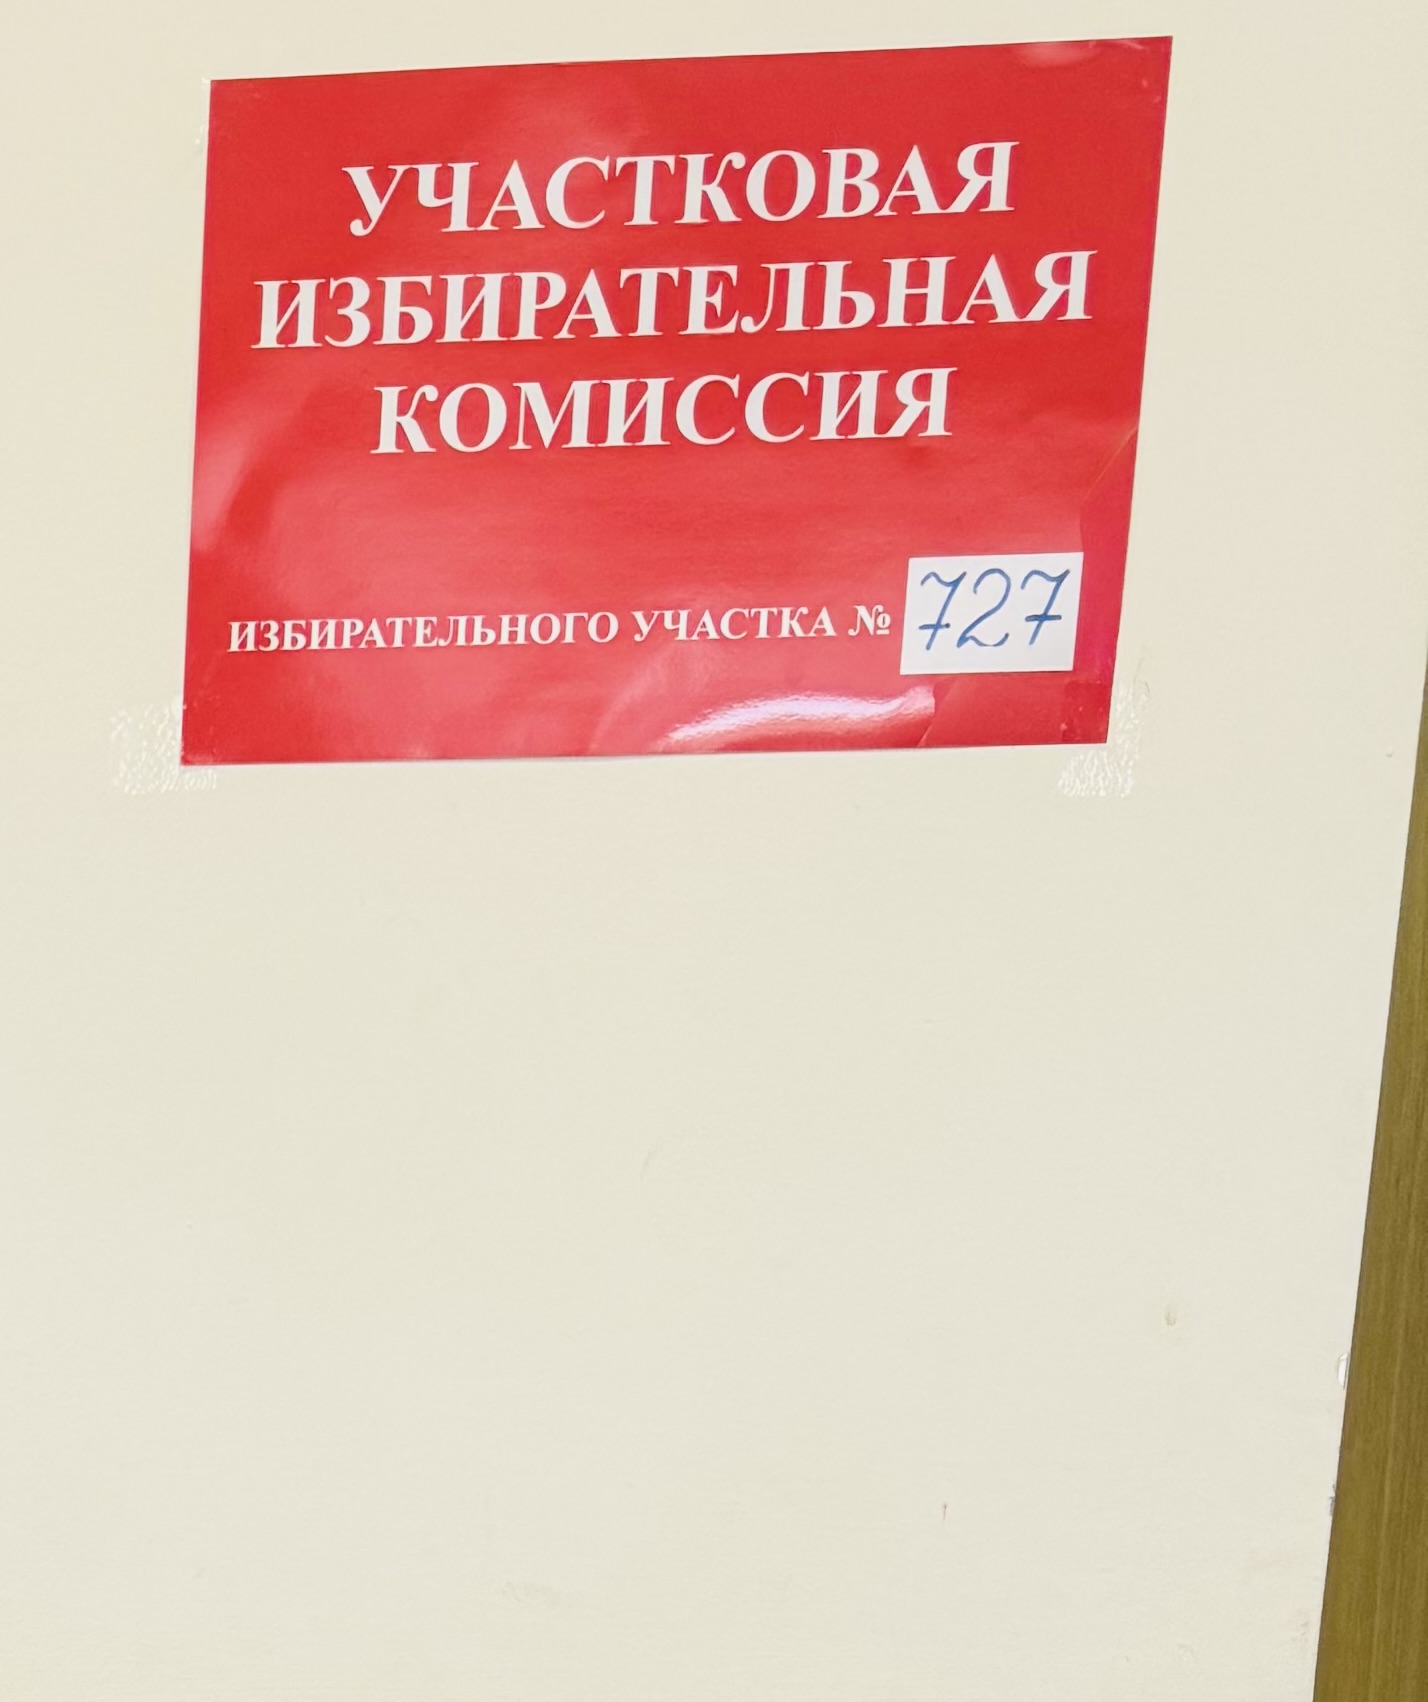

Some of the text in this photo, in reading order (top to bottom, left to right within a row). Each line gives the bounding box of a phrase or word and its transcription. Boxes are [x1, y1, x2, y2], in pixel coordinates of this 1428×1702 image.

[341, 141, 1019, 237] УЧАСТКОВАЯ
[250, 250, 1098, 350] ИЗБИРАТЕЛЬНАЯ
[369, 367, 958, 455] КОМИССИЯ
[227, 567, 1073, 653] ИЗБИРАТЕЛЬНОГО УЧАСТКА № 727
